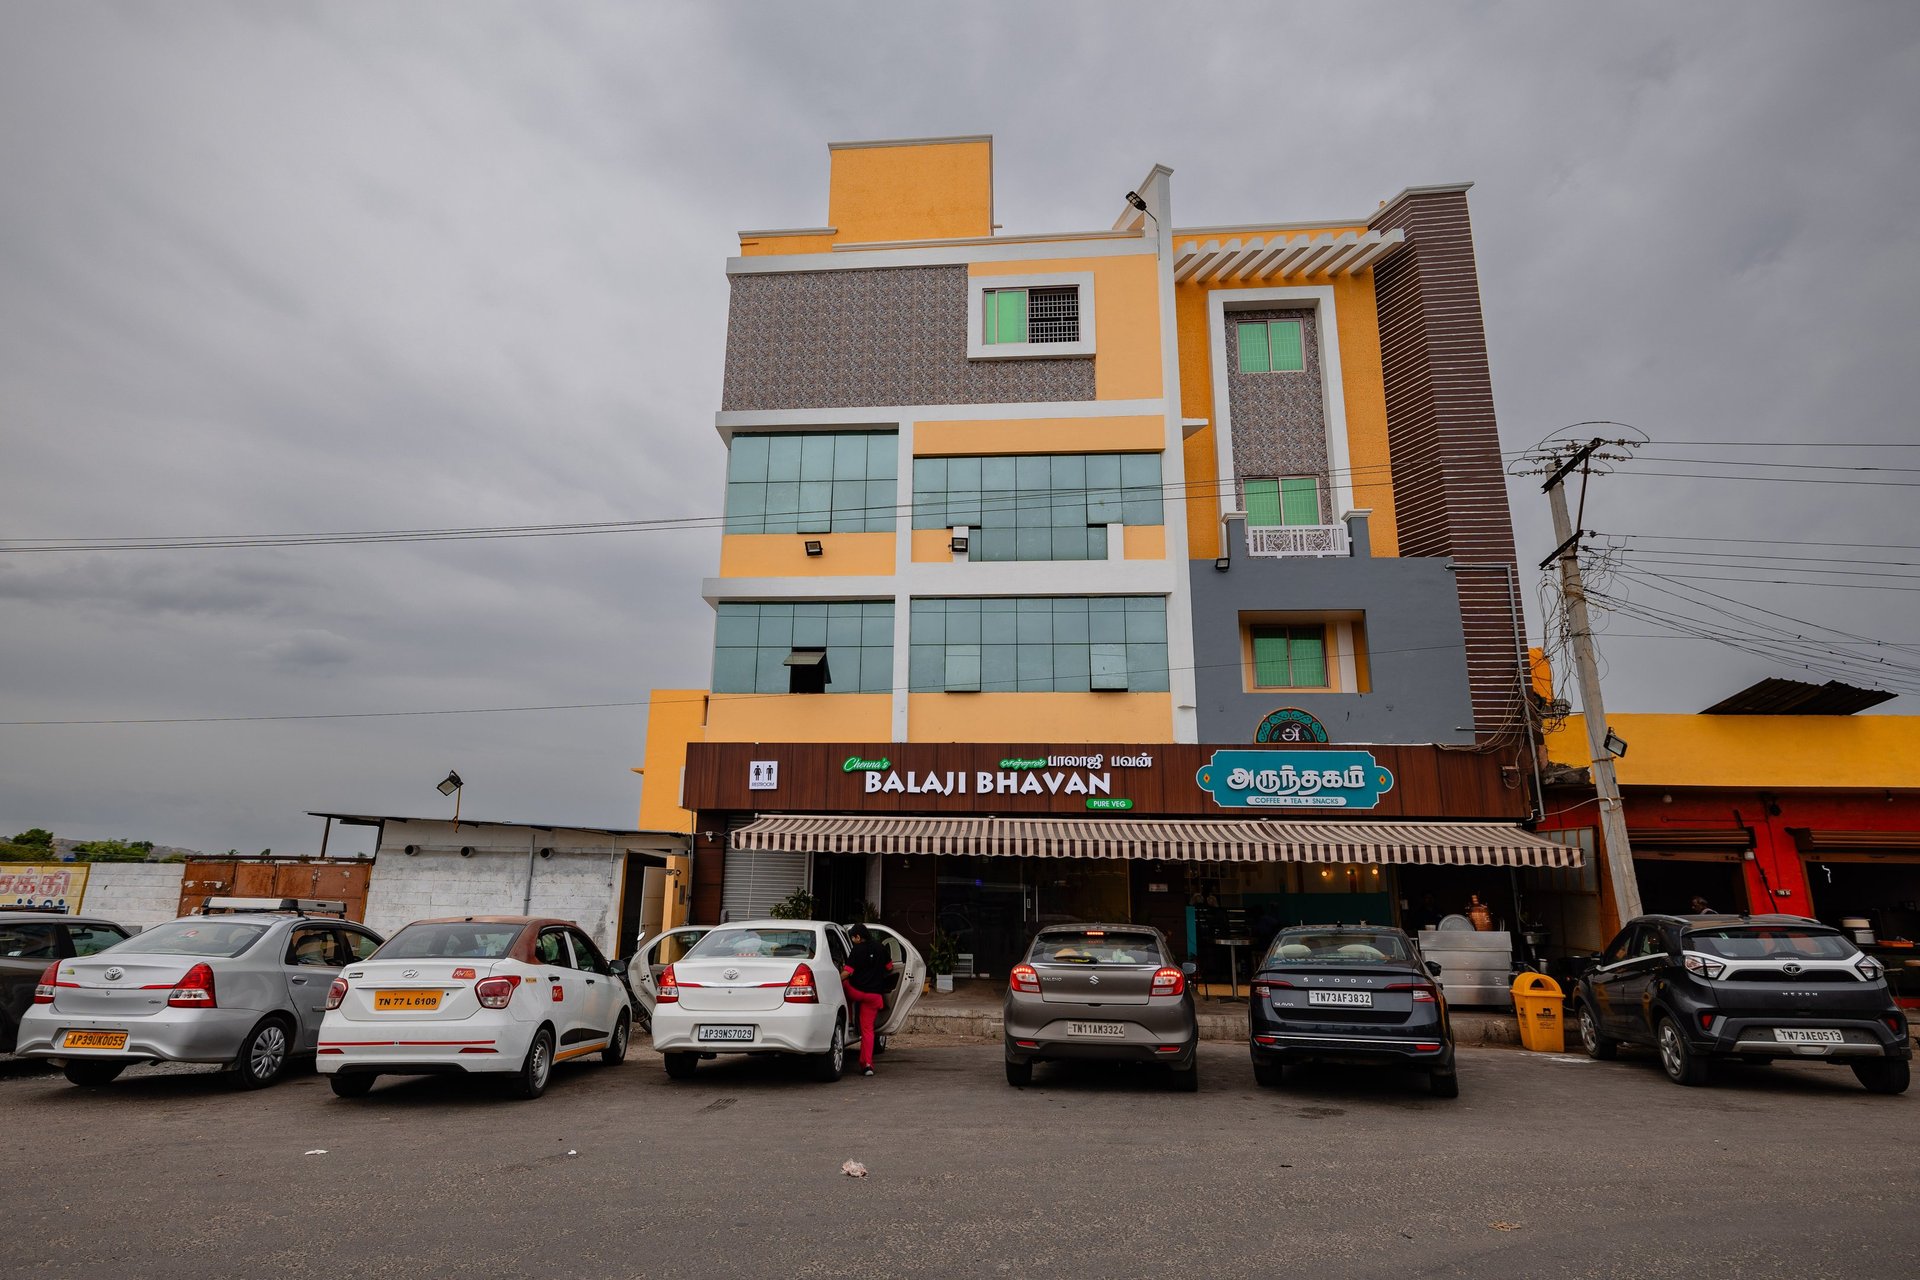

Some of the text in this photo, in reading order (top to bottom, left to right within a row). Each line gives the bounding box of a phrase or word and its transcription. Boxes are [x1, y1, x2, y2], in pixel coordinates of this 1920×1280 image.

[843, 757, 890, 772] Chenna's
[1048, 753, 1104, 770] பாலாஜி
[1111, 752, 1153, 768] பவன்
[865, 770, 1111, 796] BALAJI BHAVAN
[1227, 765, 1366, 796] அருந்தகம்
[1312, 797, 1339, 805] SNACKS
[379, 998, 437, 1006] TN 77 L 6109
[1315, 992, 1371, 1004] TN73AF3832
[1782, 1030, 1842, 1041] TN73AE0513
